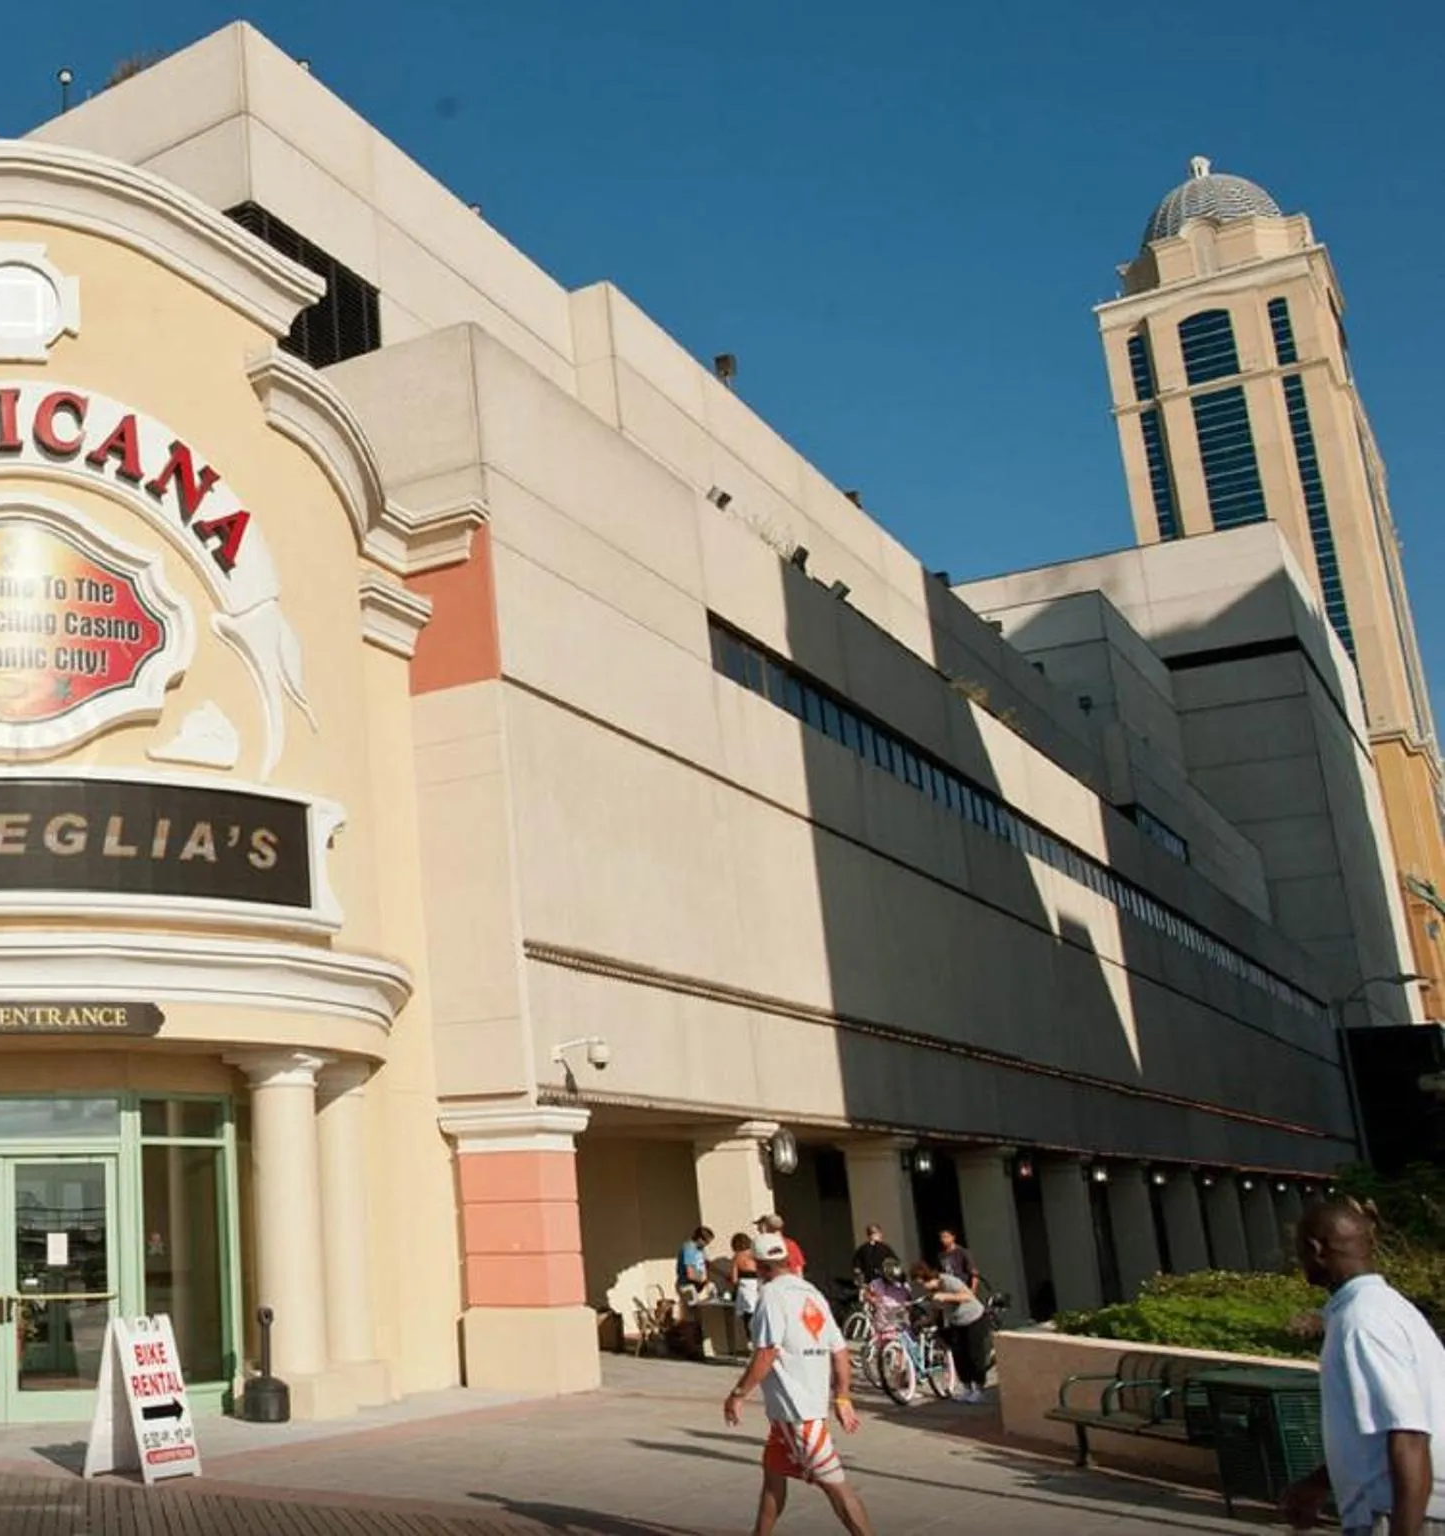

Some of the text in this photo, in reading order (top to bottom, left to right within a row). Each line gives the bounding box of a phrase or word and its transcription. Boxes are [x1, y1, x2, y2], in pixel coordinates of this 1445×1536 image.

[43, 574, 67, 599] To
[76, 577, 115, 604] The
[64, 611, 141, 642] Casino
[55, 649, 108, 675] City!
[133, 1342, 168, 1367] BIKE
[130, 1371, 183, 1397] RENTAL
